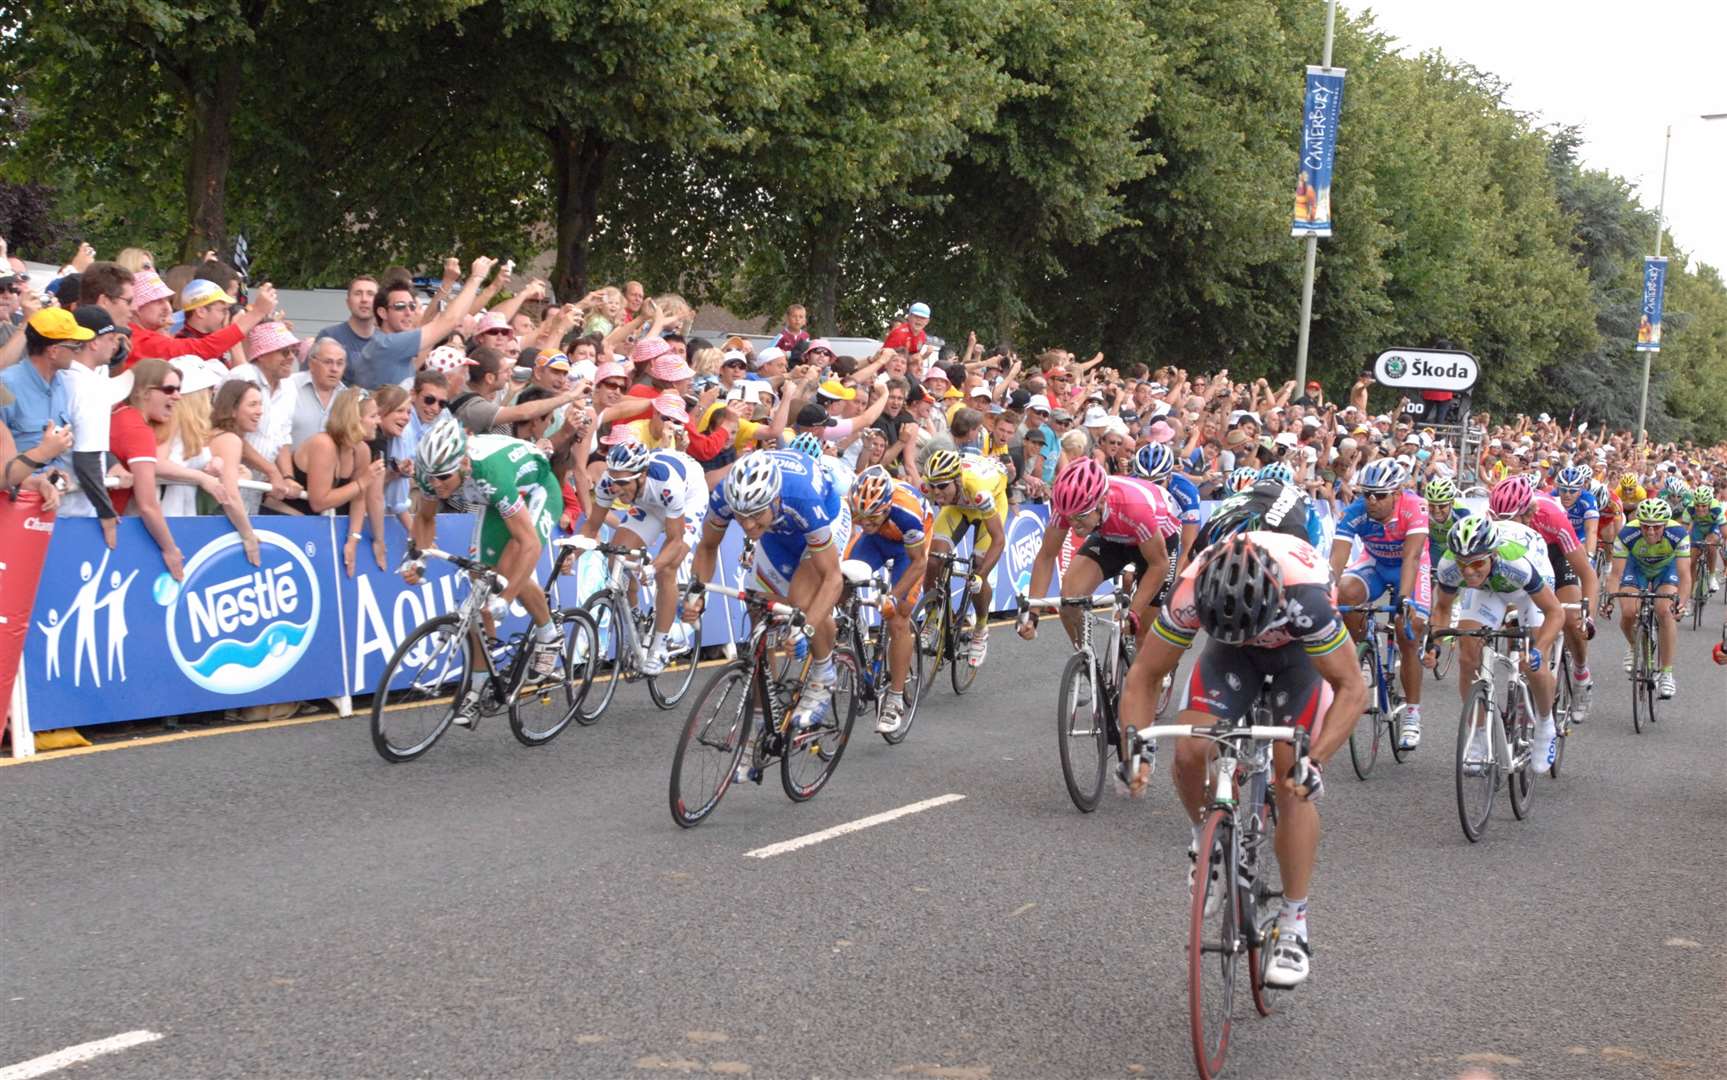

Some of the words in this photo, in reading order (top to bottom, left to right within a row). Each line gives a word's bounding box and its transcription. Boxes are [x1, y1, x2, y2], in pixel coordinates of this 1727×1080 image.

[1304, 81, 1333, 171] CANTERBURY
[1411, 357, 1469, 379] Škoda
[186, 560, 299, 644] Nestlé
